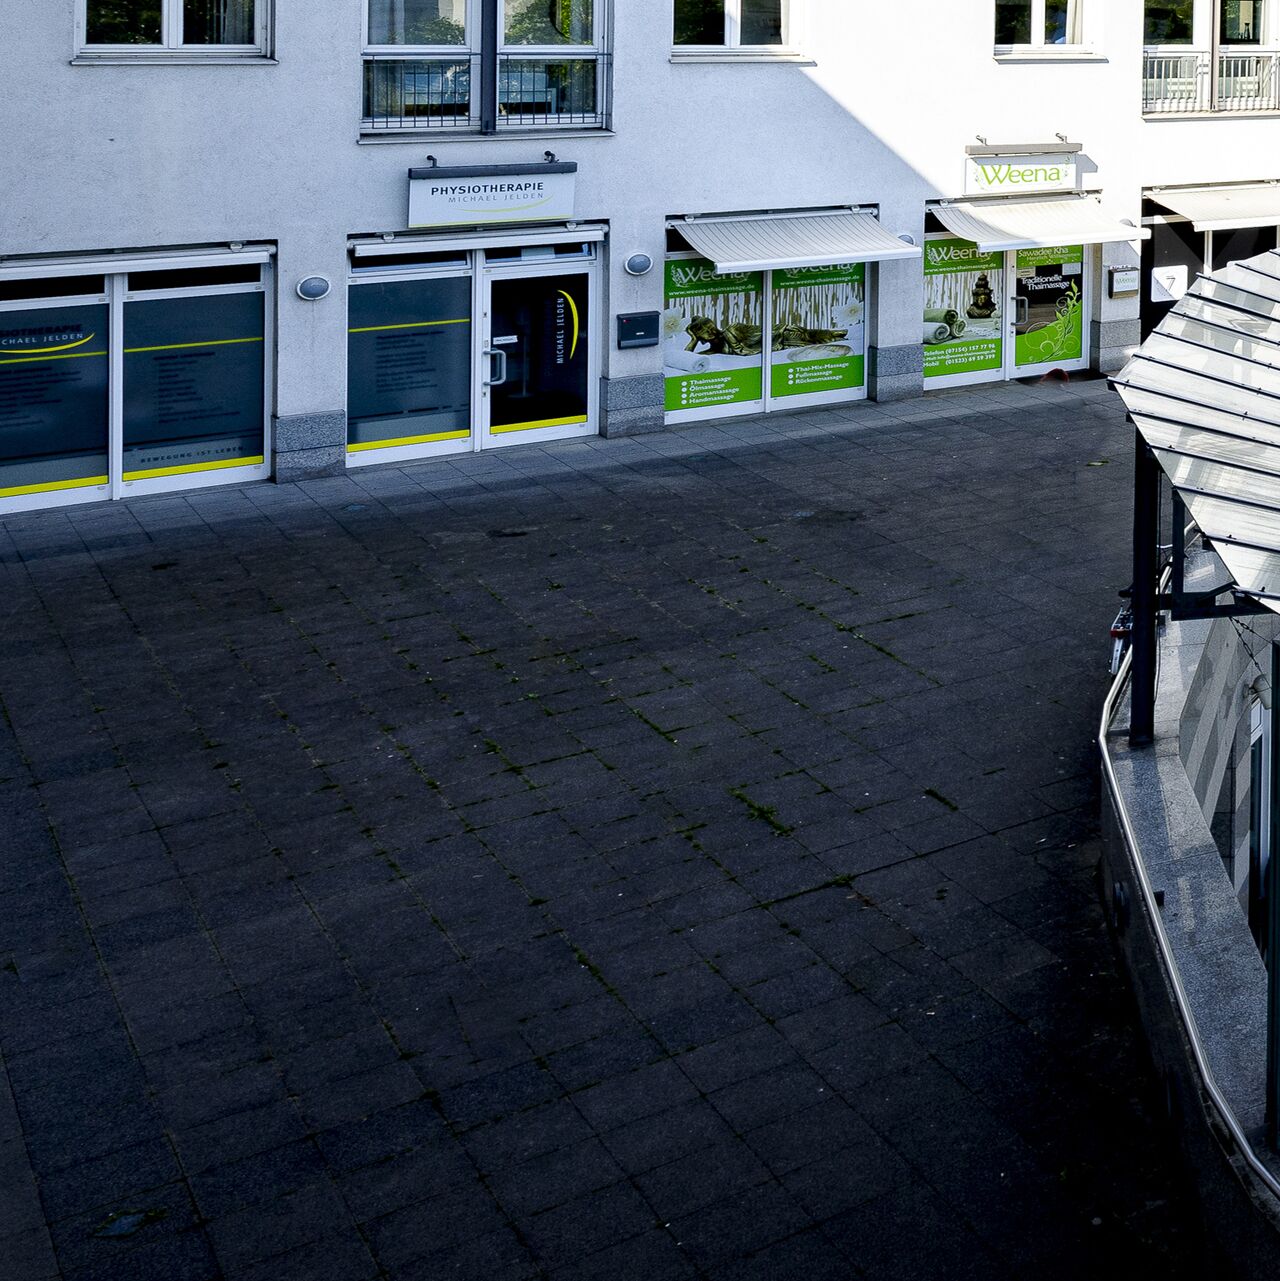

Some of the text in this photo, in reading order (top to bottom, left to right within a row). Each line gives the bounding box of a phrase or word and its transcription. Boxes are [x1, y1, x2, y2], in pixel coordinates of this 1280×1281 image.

[981, 163, 1061, 185] Weena
[431, 182, 544, 196] PHYSIOTHERAPIE
[448, 192, 544, 203] MICHAEL JELDEN
[1021, 274, 1063, 285] Traditionelle
[1028, 281, 1070, 291] Thaimassage
[557, 298, 565, 364] MICHAEL JELDEN
[43, 332, 84, 342] JELDEN
[689, 376, 732, 386] Thaimassage
